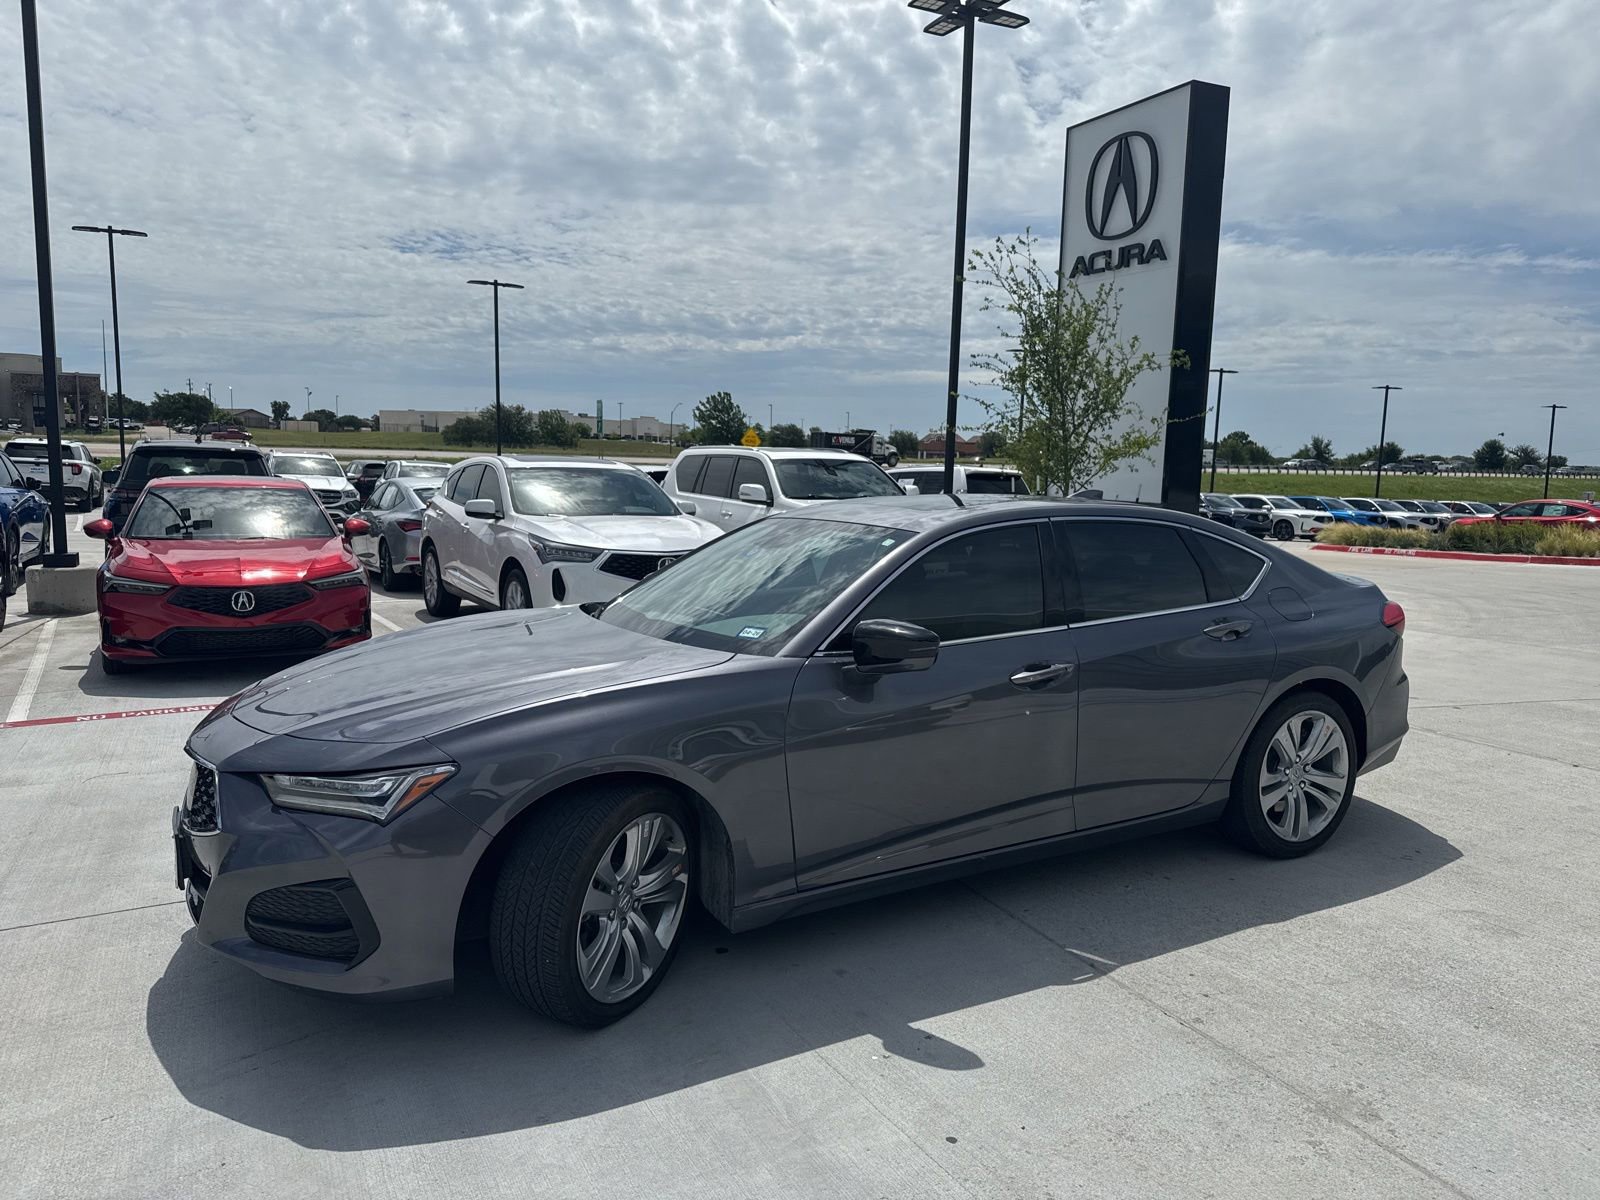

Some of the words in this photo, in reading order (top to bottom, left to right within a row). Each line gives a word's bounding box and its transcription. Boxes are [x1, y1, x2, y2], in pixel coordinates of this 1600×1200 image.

[1068, 238, 1168, 279] ACURA
[76, 714, 107, 722] NO
[121, 705, 215, 718] PARKING
